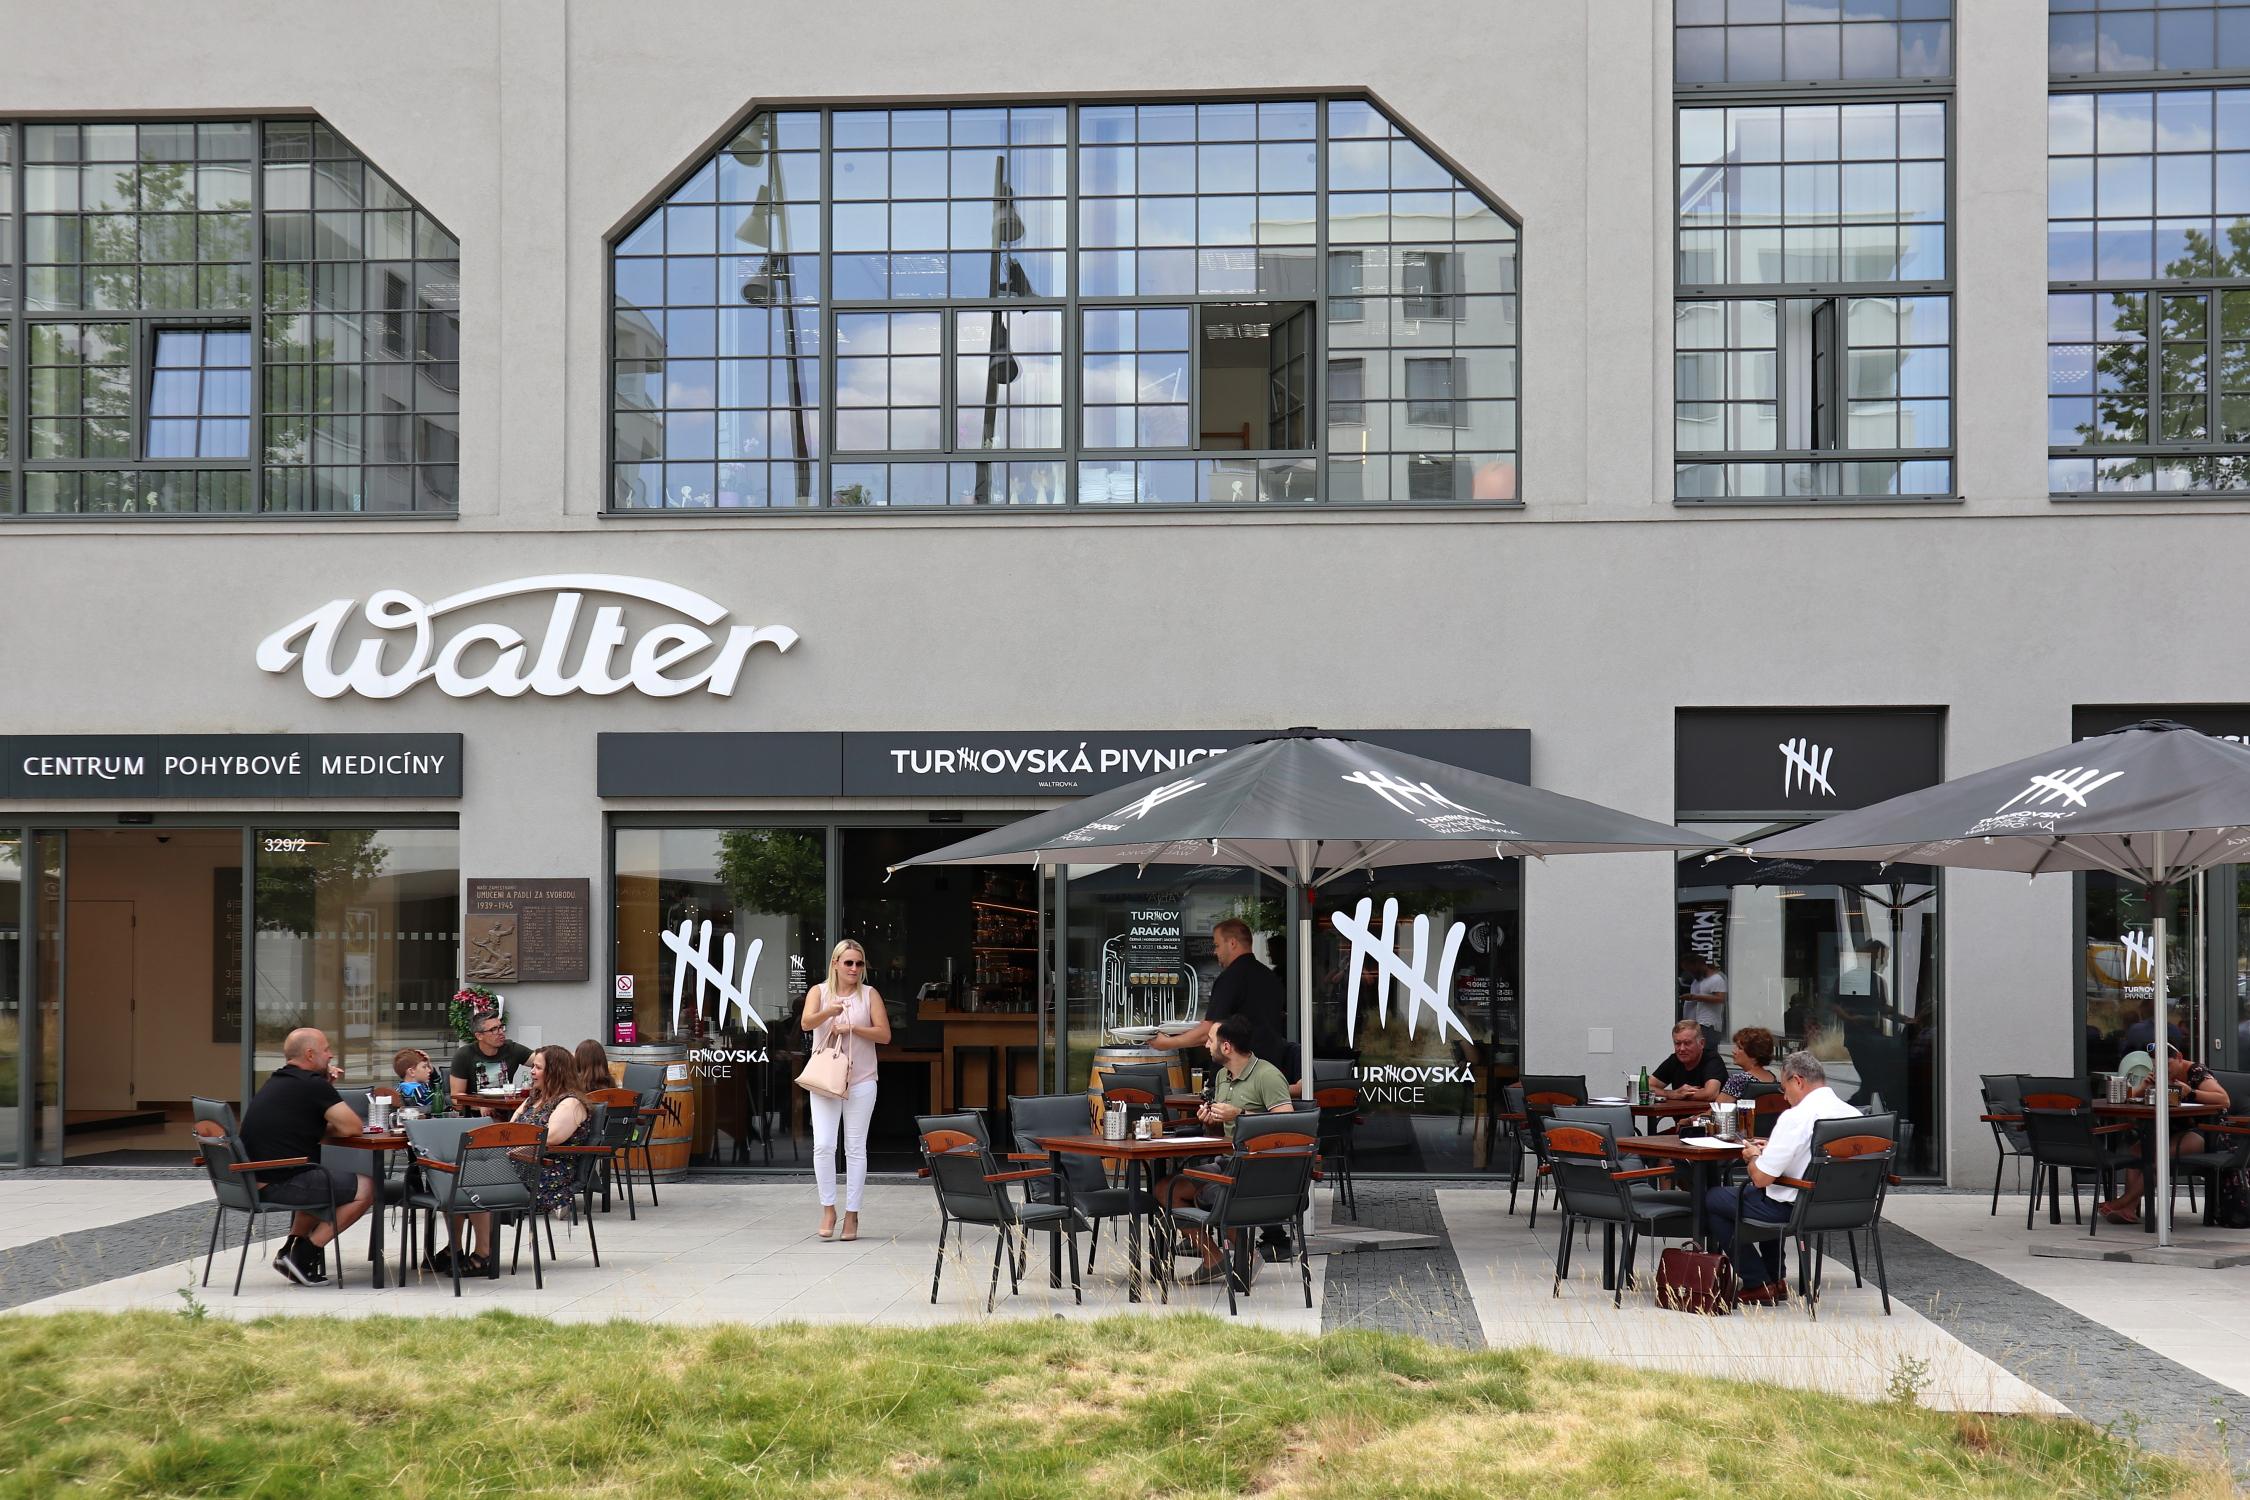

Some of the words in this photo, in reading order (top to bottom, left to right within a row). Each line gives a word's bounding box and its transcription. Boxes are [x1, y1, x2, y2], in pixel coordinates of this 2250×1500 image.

[255, 573, 800, 699] Walter
[22, 756, 145, 780] CENTRUM
[164, 752, 302, 776] POHYBOVÉ
[321, 751, 446, 775] MEDICÍNY
[1100, 748, 1228, 773] PIVNIC
[1038, 780, 1078, 788] WALTROVKA
[264, 838, 307, 852] 329/2
[534, 891, 543, 899] ZA
[546, 891, 576, 899] SVOBODU
[477, 901, 514, 910] 1939-1945
[1129, 927, 1180, 936] ARAKAIN
[2124, 992, 2154, 1000] PIVNICE
[687, 1046, 770, 1063] RNOVSKÁ
[690, 1065, 732, 1078] NICE
[1352, 1062, 1477, 1083] URNOVSKÁ
[1359, 1086, 1425, 1103] VNICE
